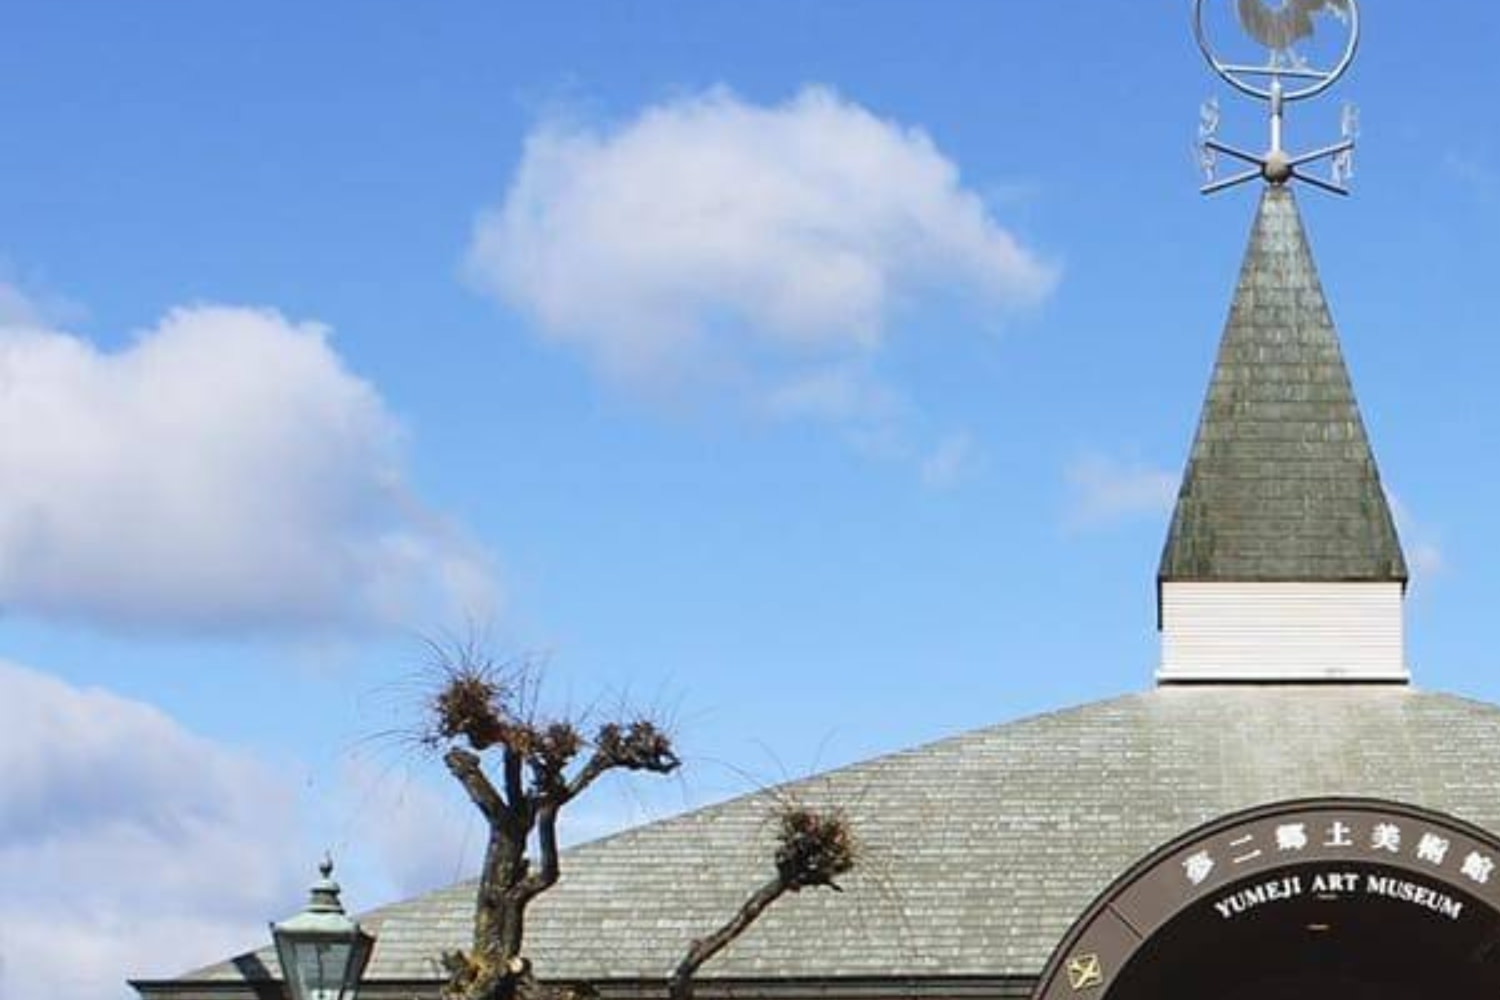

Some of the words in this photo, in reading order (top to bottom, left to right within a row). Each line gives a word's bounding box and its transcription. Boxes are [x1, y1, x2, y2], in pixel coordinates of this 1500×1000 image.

[1213, 876, 1302, 919] YUMEJI
[1311, 873, 1360, 892] ART
[1366, 874, 1464, 920] MUSEUM
